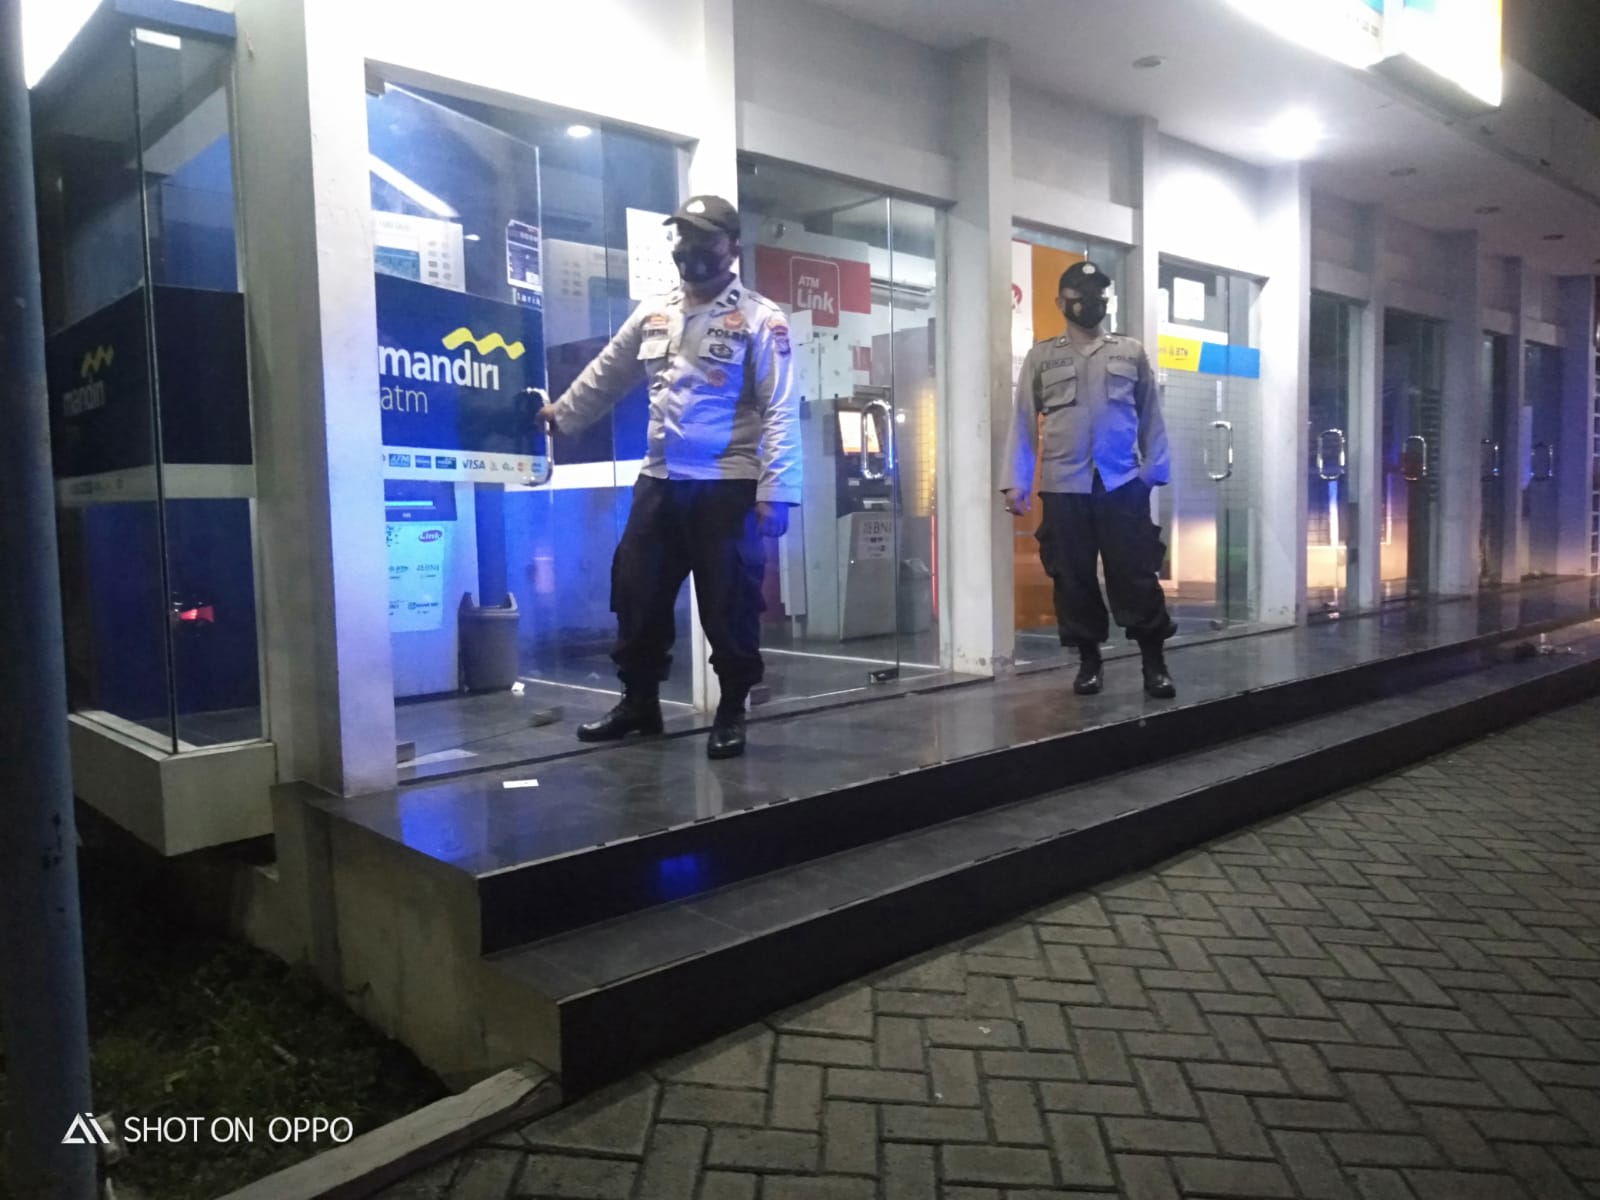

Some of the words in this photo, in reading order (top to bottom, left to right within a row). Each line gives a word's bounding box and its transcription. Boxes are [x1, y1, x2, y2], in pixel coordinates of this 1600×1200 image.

[798, 275, 821, 288] ATM
[797, 288, 835, 315] Link
[378, 346, 500, 390] mandiri
[380, 385, 429, 414] atm
[462, 459, 486, 470] VISA
